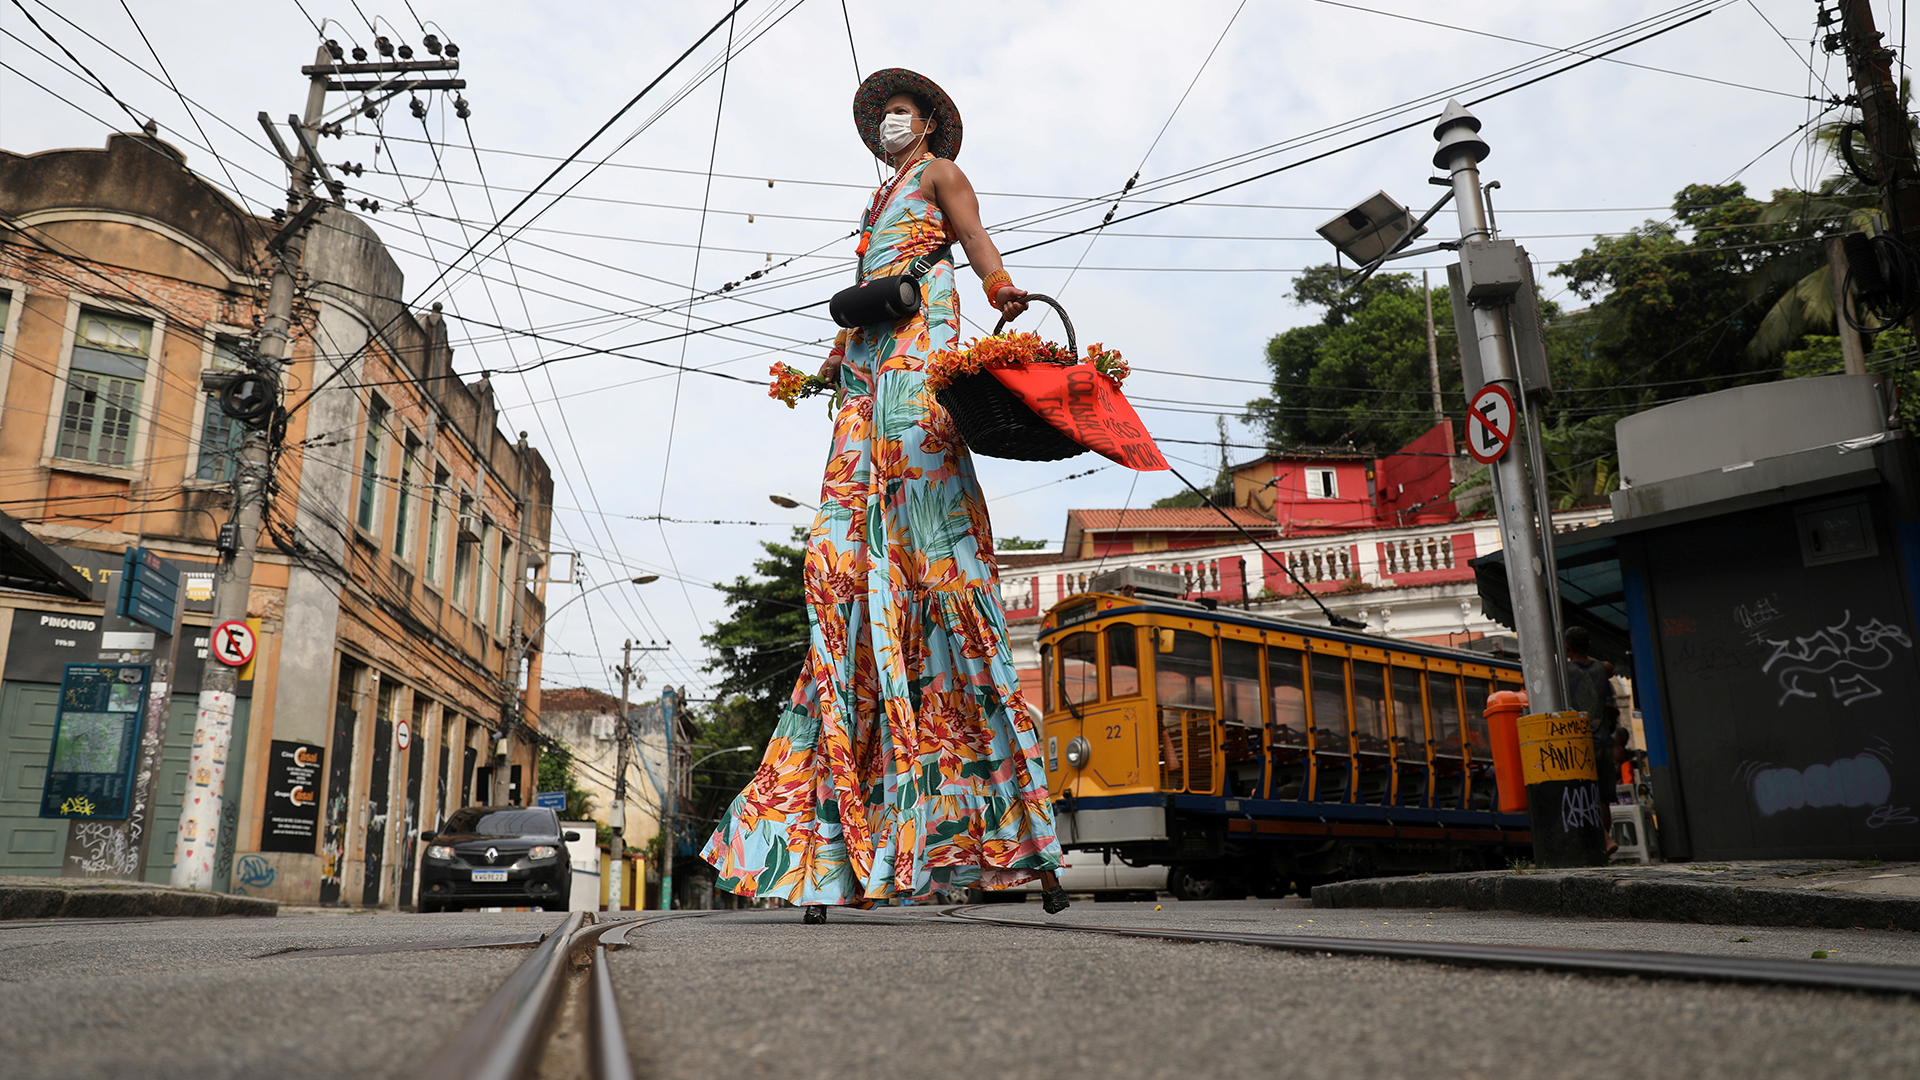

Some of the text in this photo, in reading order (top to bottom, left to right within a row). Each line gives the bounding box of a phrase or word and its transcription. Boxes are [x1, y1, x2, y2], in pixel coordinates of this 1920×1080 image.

[1479, 401, 1500, 450] E
[1121, 443, 1163, 469] AMOR
[41, 615, 96, 631] PINOQUIO
[225, 629, 244, 656] E
[1106, 724, 1121, 739] 22
